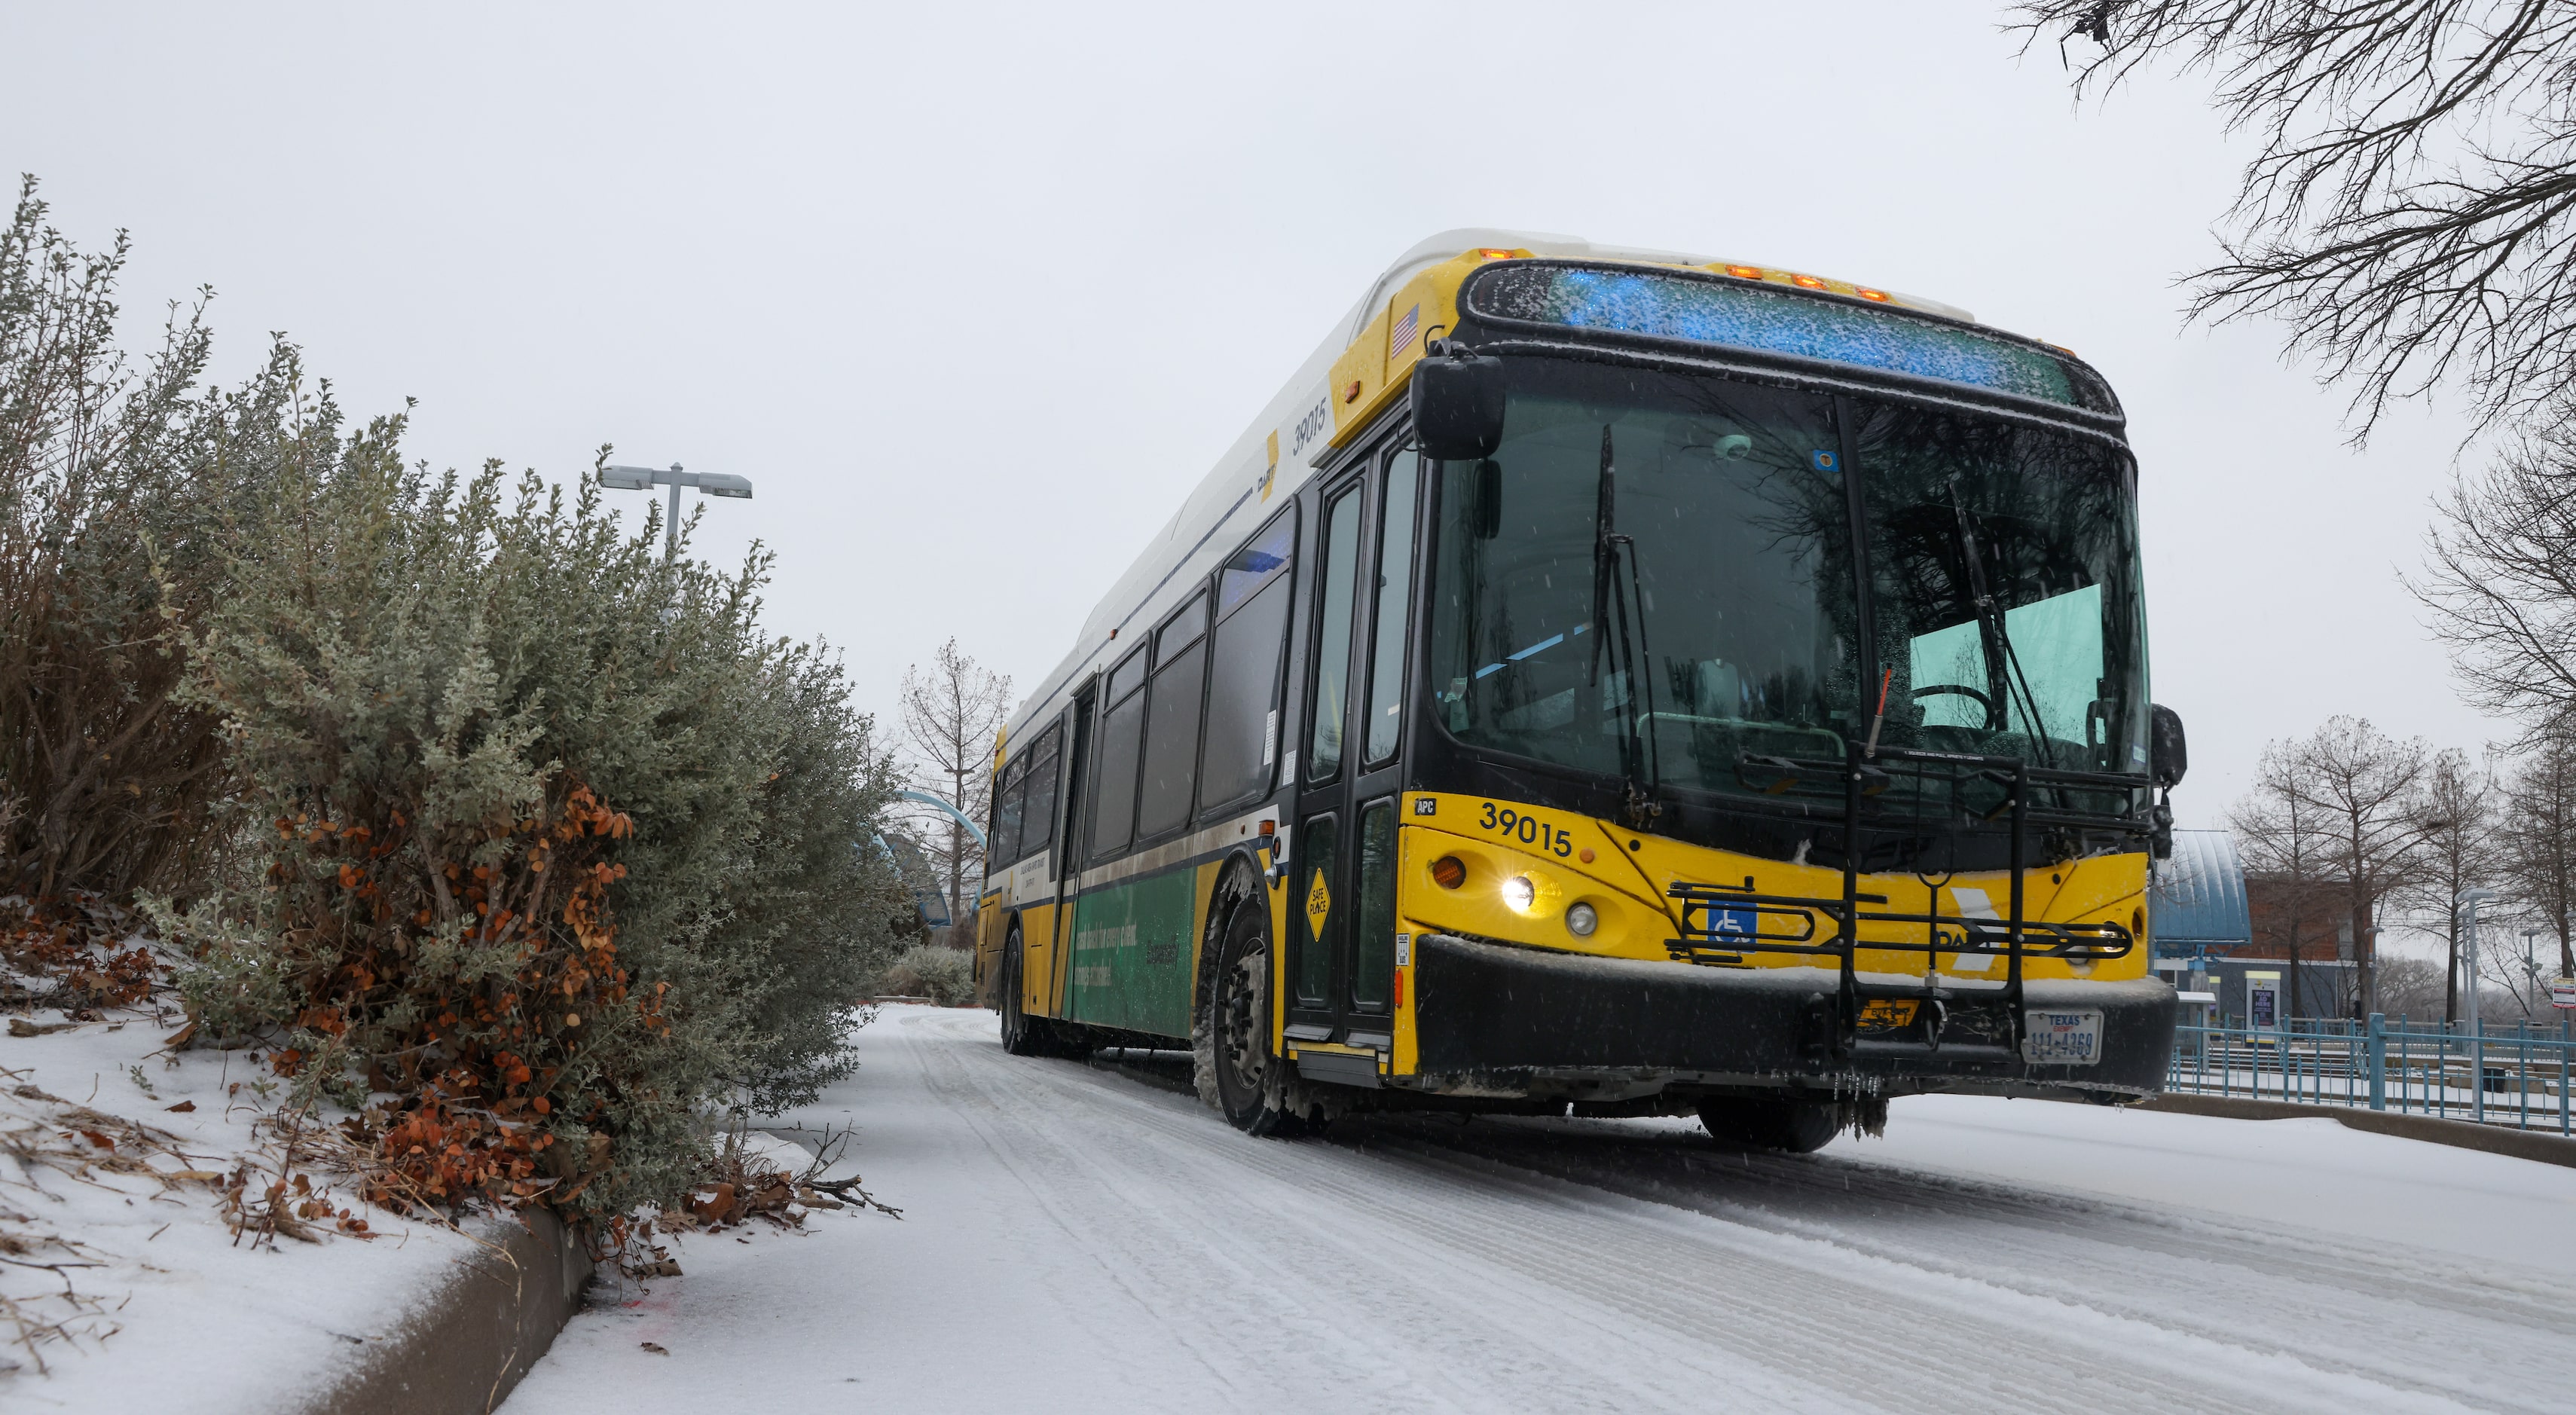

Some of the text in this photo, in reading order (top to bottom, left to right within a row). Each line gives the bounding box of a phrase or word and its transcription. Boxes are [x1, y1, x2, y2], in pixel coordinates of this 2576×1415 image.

[1293, 396, 1327, 457] 39015
[1257, 463, 1276, 493] DART
[1417, 800, 1434, 813] APC
[1479, 802, 1572, 857] 39015
[1313, 888, 1323, 901] SAFE
[1310, 900, 1325, 915] PLACE
[1099, 921, 1107, 949] for
[1106, 927, 1121, 955] every
[2049, 1015, 2080, 1025] TEXAS
